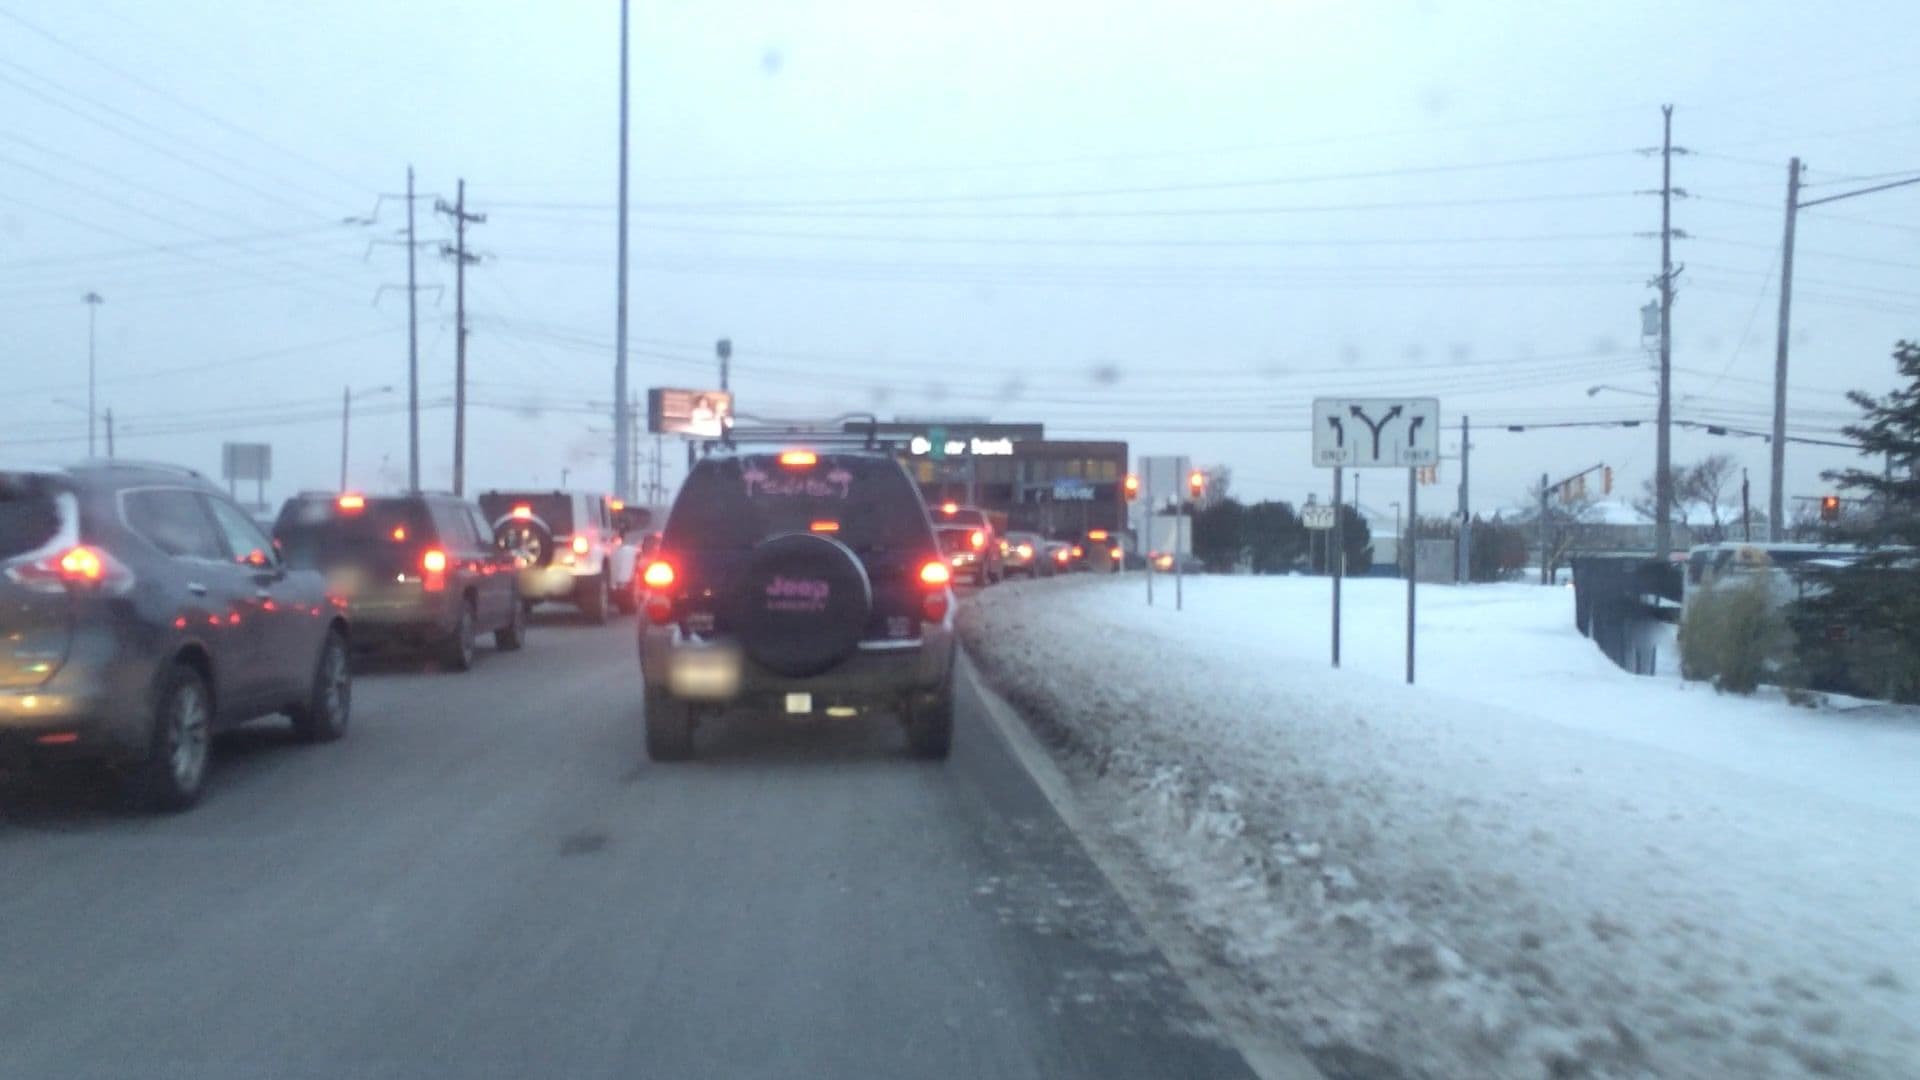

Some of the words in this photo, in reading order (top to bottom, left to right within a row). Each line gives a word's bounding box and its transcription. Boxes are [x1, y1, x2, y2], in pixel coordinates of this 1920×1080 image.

[1320, 450, 1348, 461] ONLY
[1403, 450, 1430, 461] ONLY
[766, 576, 829, 600] Jeep
